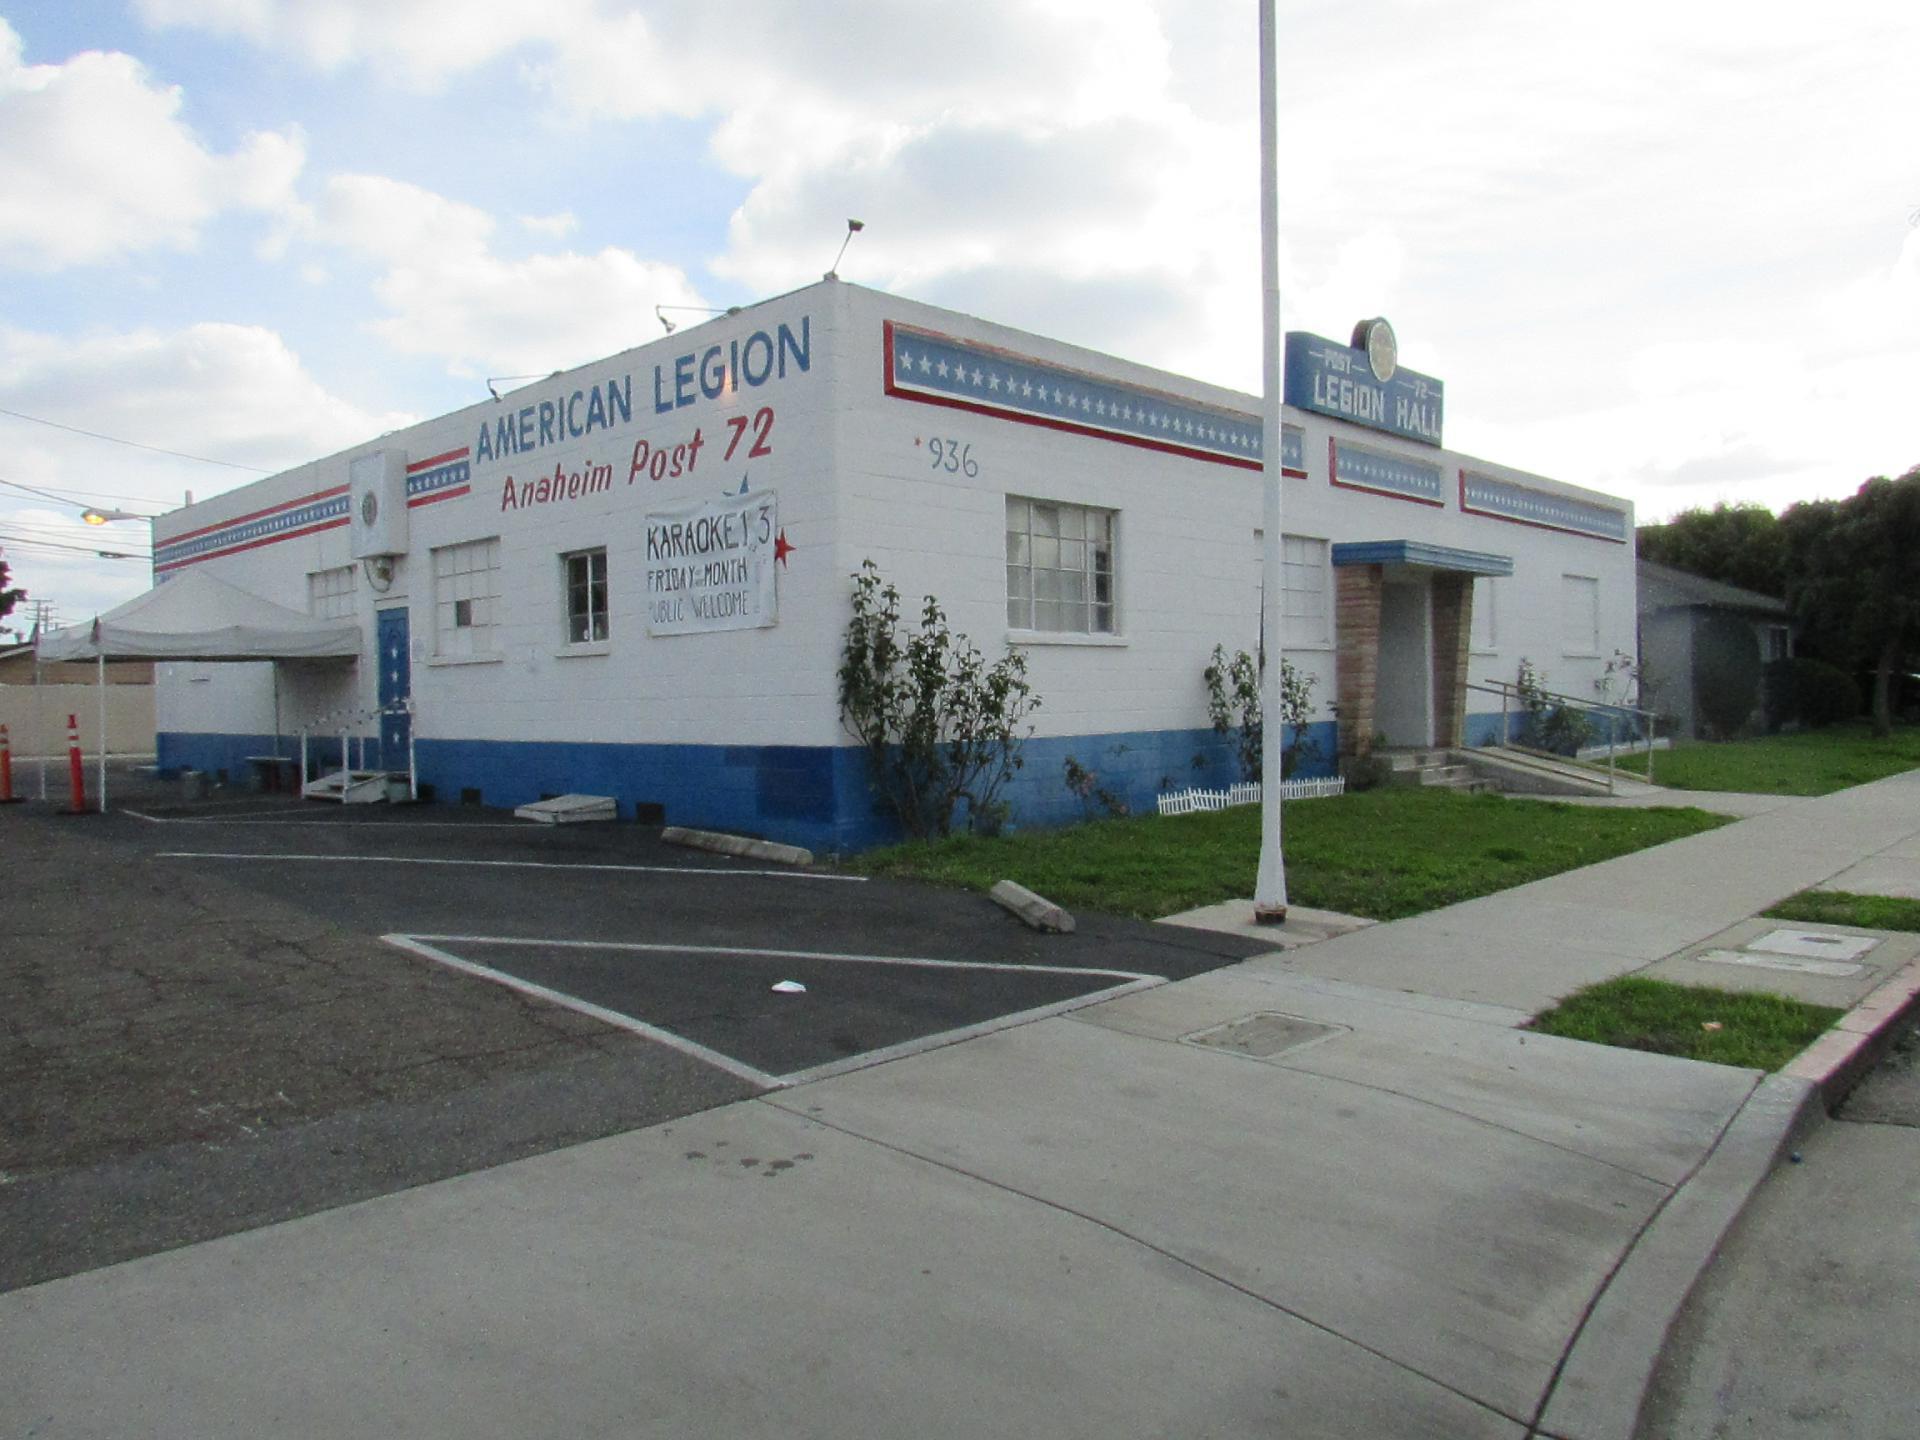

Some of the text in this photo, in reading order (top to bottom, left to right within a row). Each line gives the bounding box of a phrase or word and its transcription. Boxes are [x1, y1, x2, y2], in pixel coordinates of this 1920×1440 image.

[476, 316, 811, 464] AMERICAN LEGION
[1313, 373, 1385, 423] LEGION
[501, 407, 775, 513] Anaheim Post 72
[929, 437, 979, 478] 936
[647, 510, 739, 561] KARAOKE
[704, 556, 748, 587] MONTH
[692, 590, 750, 619] WELCOME
